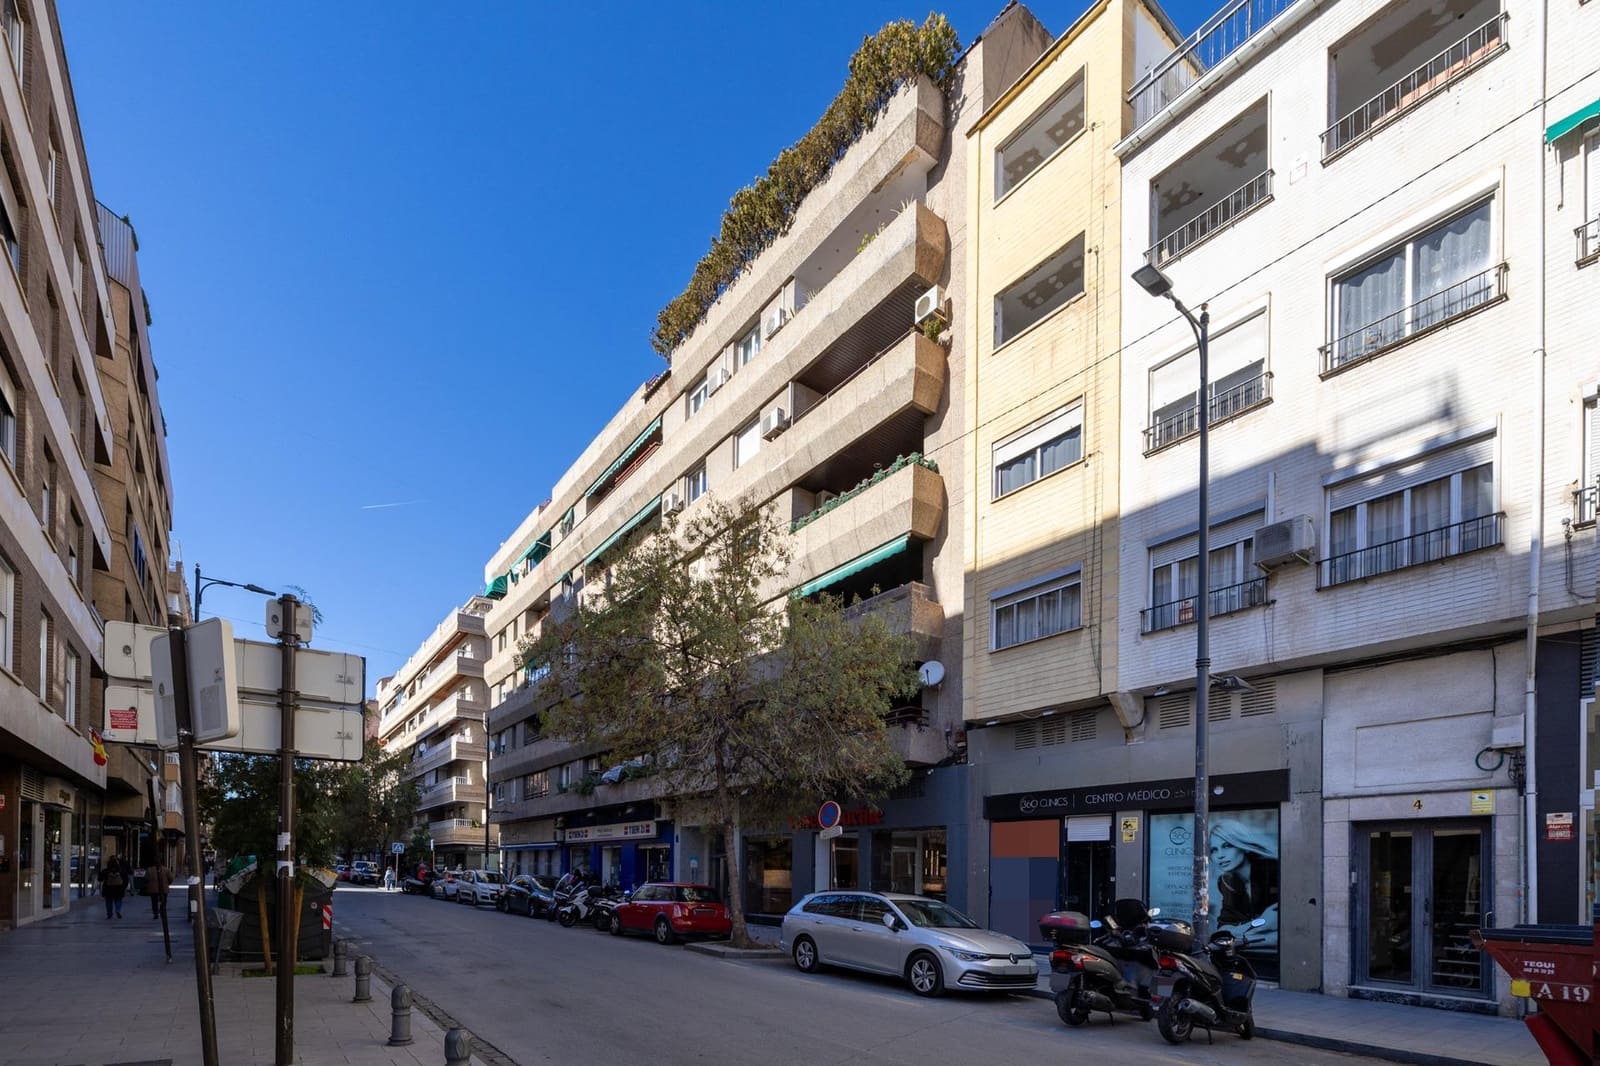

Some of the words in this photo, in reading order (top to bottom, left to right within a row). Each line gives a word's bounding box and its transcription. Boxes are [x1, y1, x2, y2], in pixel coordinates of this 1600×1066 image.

[1085, 792, 1124, 804] CENTRO
[1126, 788, 1171, 801] MÉDICO
[1040, 797, 1069, 807] CLINICS
[1413, 799, 1423, 810] 4
[1522, 960, 1556, 969] TEGUI
[1536, 982, 1554, 1000] A
[1561, 986, 1590, 1003] 19
